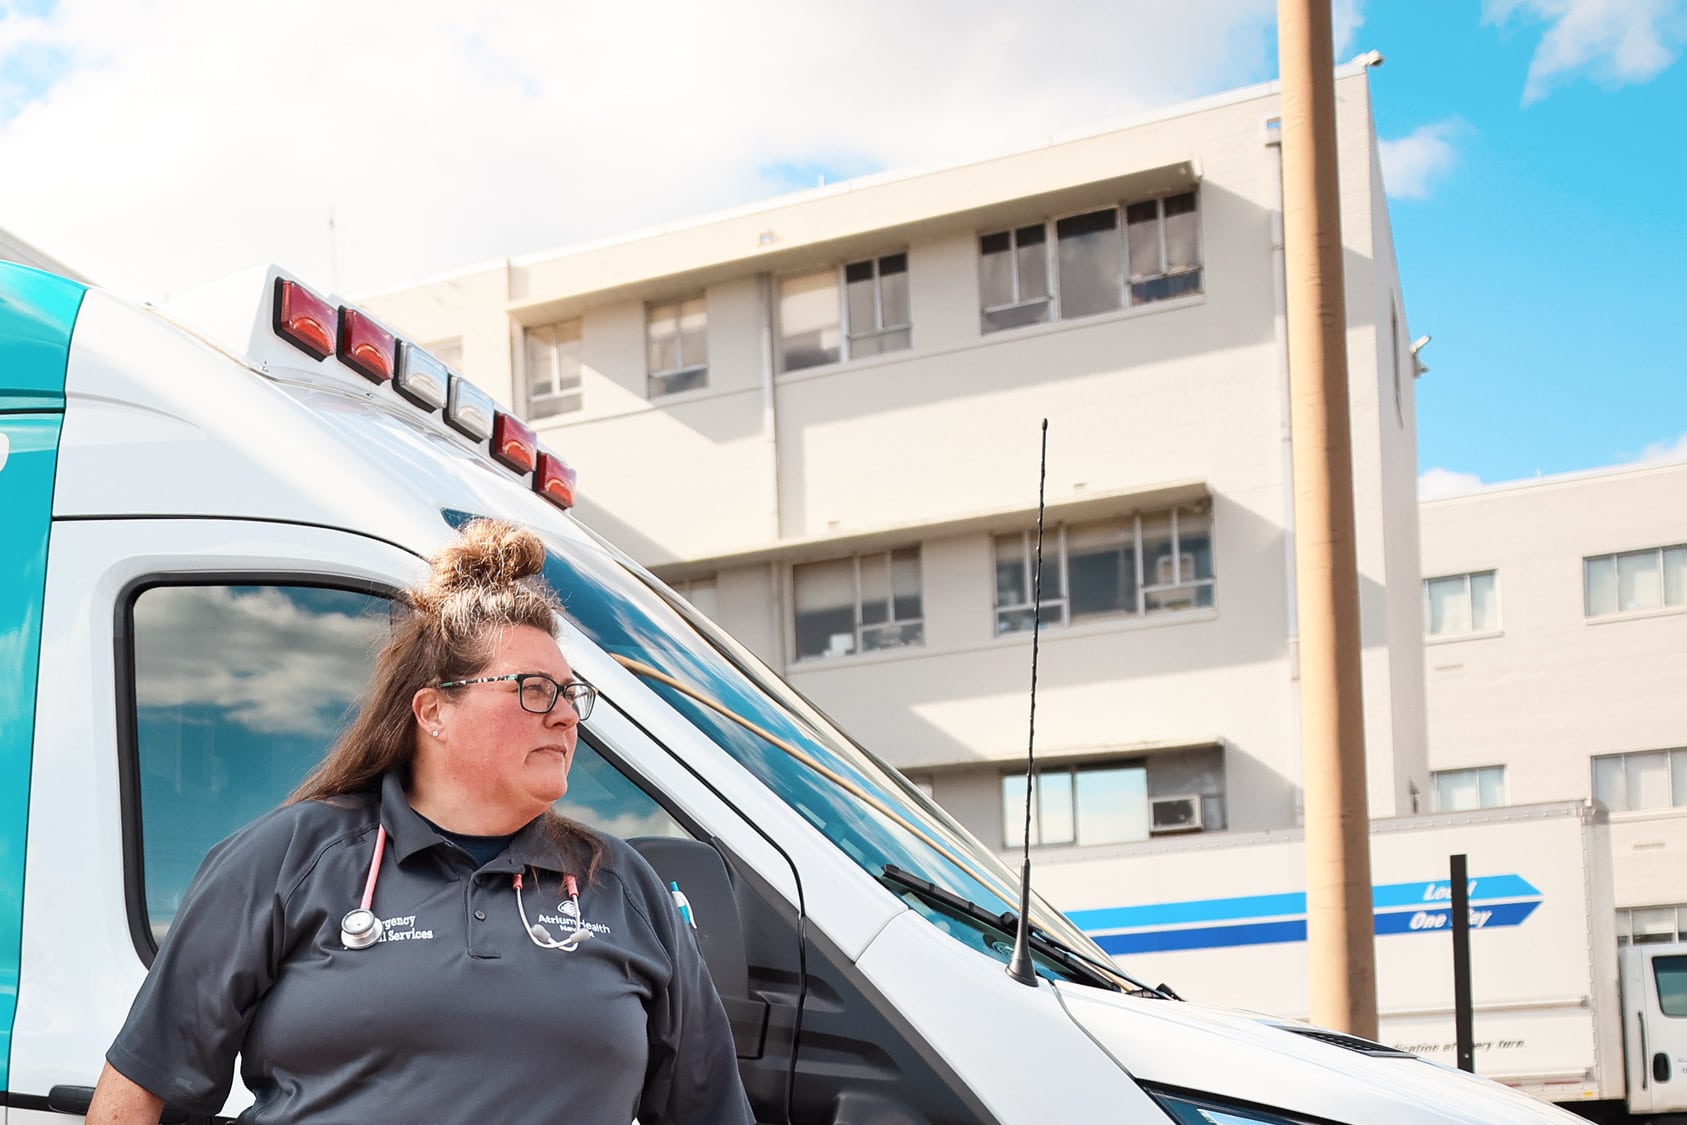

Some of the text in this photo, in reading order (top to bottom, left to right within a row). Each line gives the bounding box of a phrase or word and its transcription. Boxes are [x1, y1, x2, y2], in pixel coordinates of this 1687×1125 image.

[381, 915, 416, 930] rgency
[538, 914, 611, 934] Atrium Health
[1409, 911, 1448, 930] One
[388, 928, 434, 941] Services
